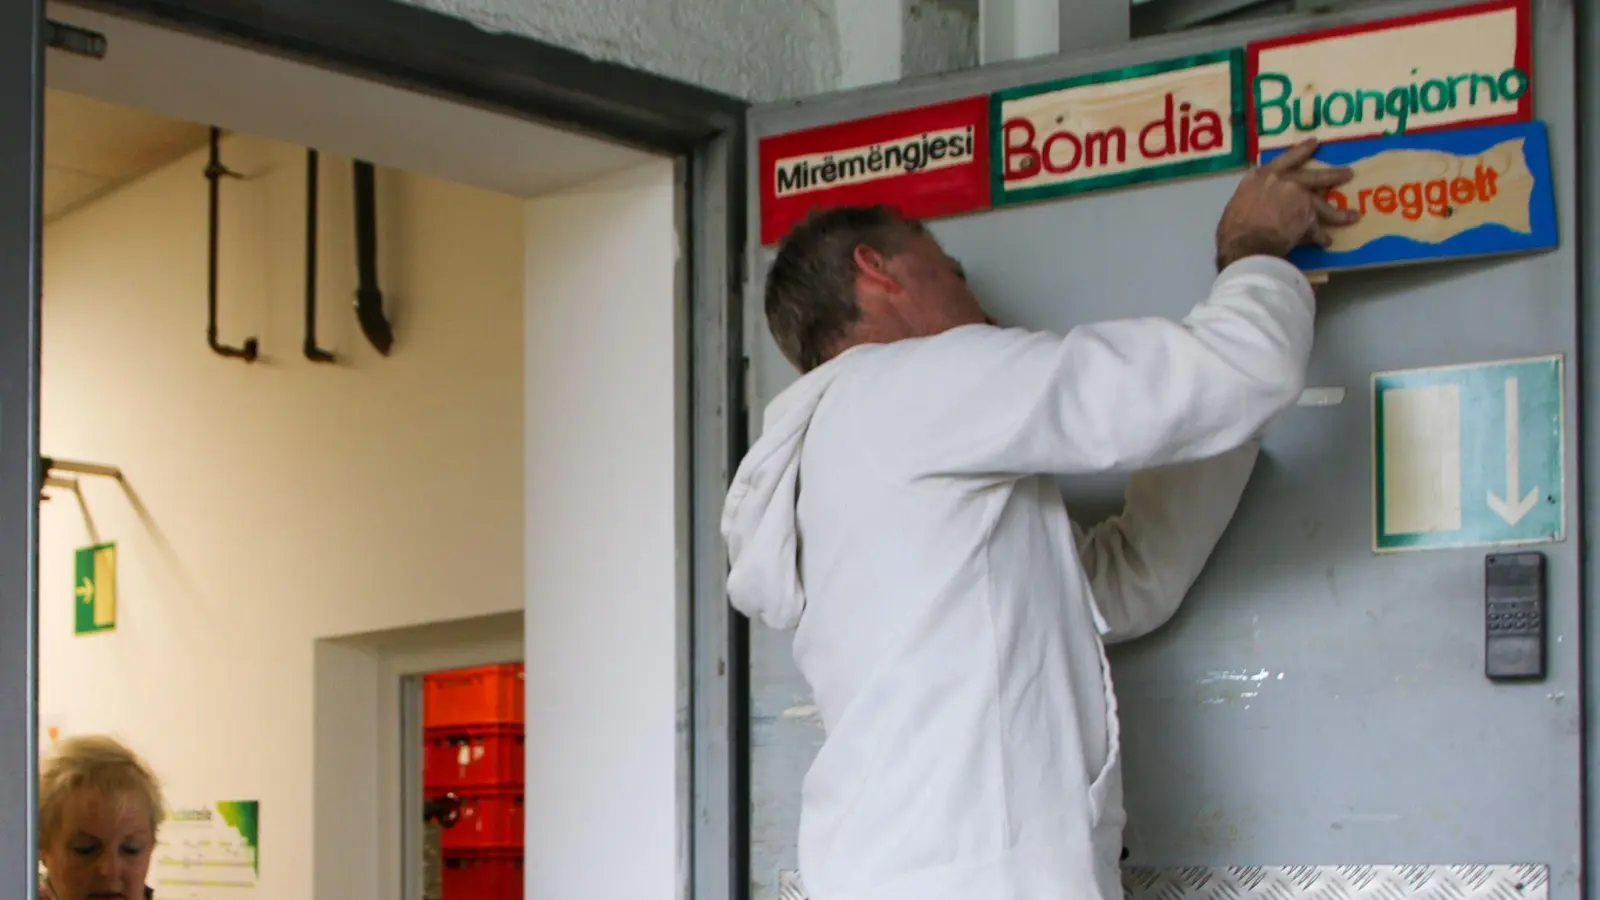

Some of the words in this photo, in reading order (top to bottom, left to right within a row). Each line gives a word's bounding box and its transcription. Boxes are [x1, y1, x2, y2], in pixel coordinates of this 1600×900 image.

[1252, 68, 1528, 136] Buongiorno
[777, 126, 973, 193] Mirëmëngjesi
[1001, 117, 1126, 181] Bom
[1138, 93, 1223, 159] dia
[1357, 162, 1499, 221] reggelt
